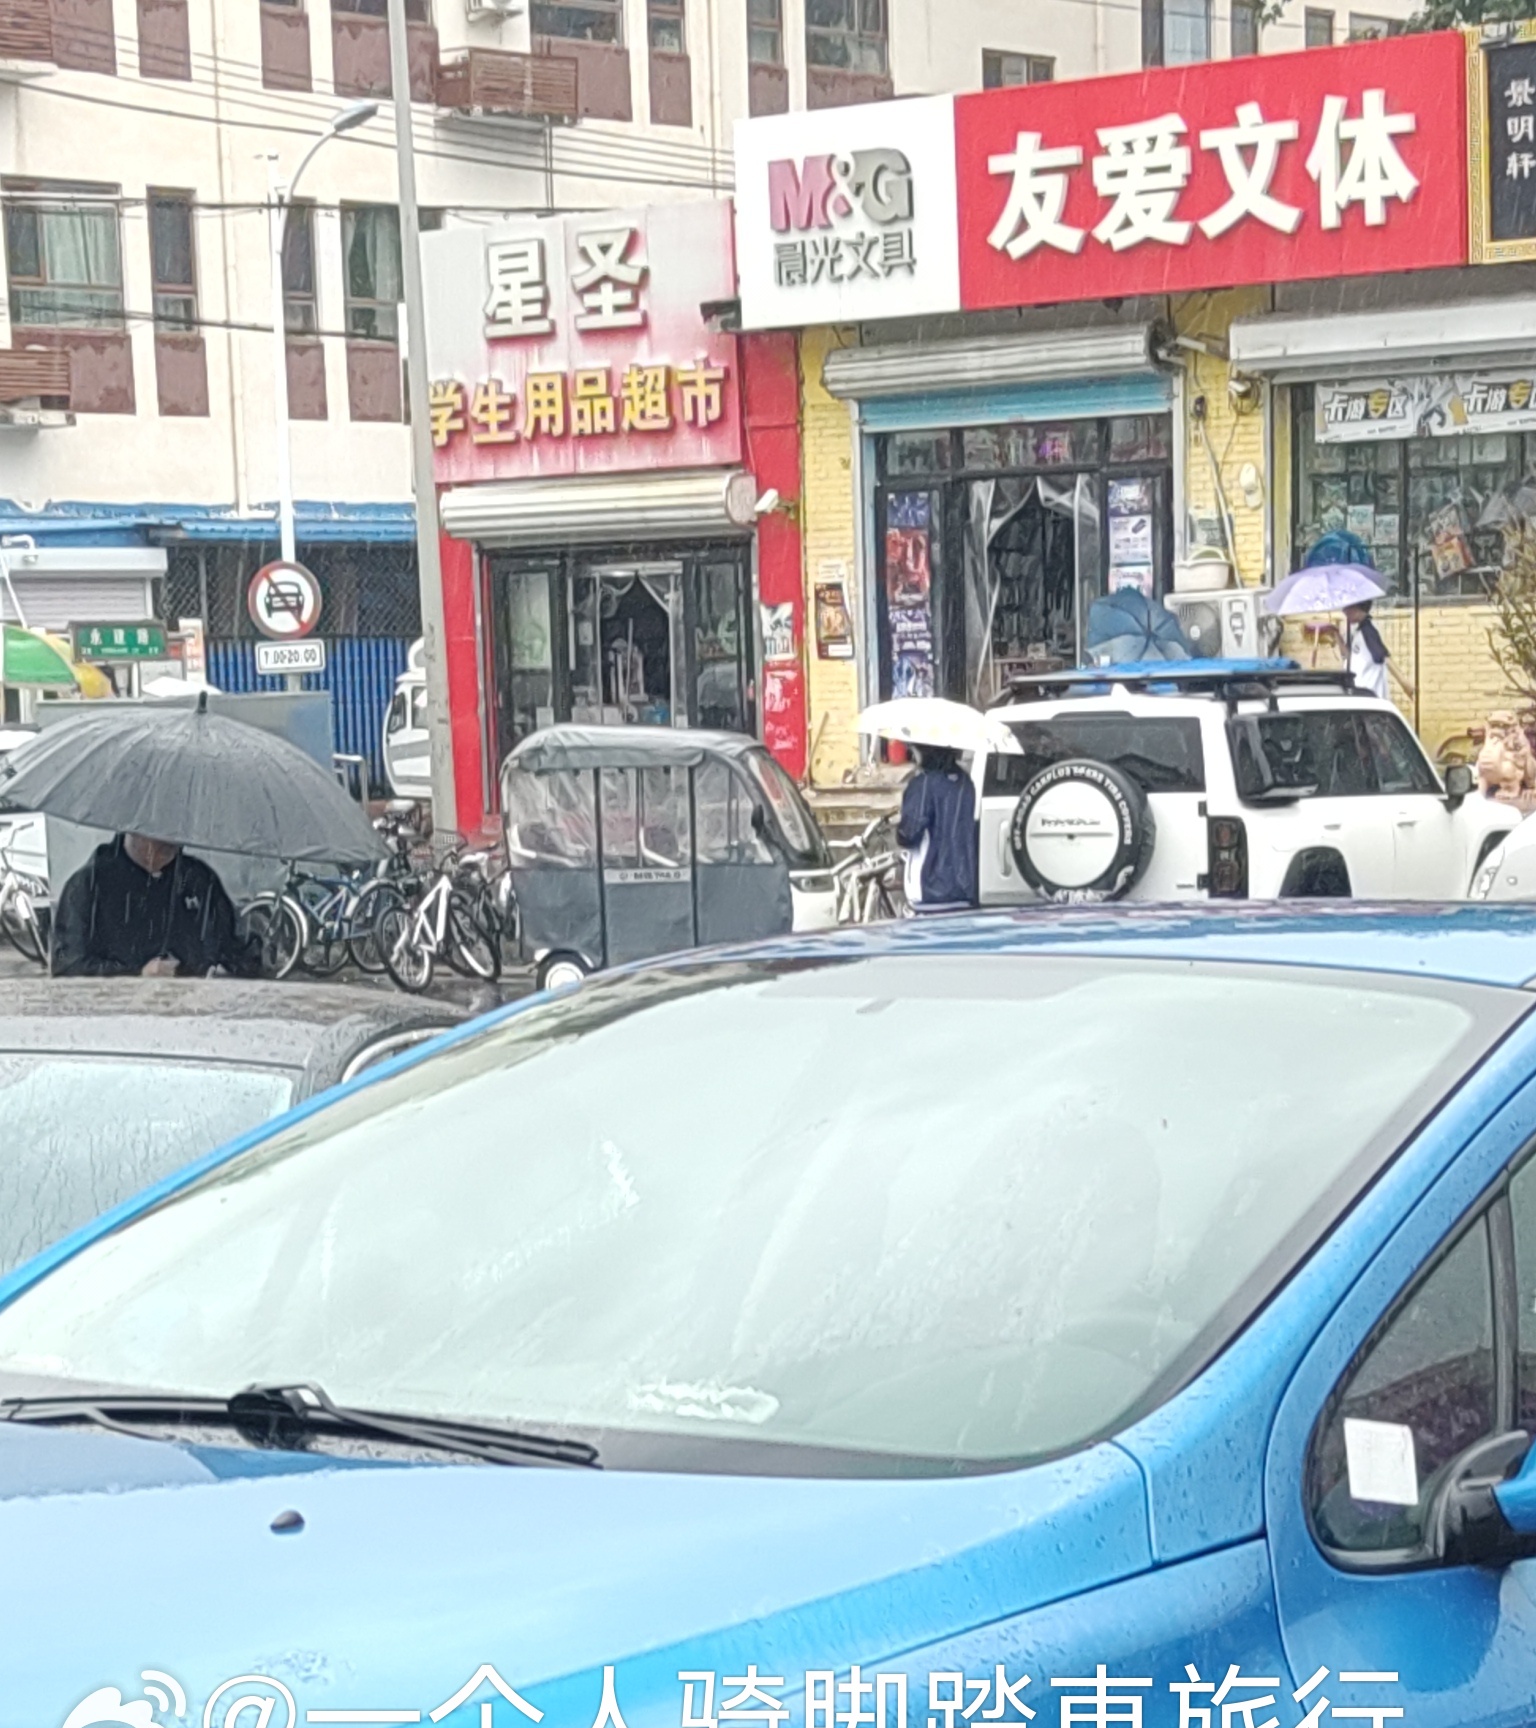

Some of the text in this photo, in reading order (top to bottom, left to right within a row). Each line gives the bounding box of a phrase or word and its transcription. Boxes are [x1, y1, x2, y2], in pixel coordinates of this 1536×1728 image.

[767, 147, 915, 234] M&G
[985, 87, 1421, 261] 友爱文体
[482, 227, 651, 341] 星圣
[773, 227, 917, 288] 晨光文具
[429, 353, 731, 448] 学生用品超市
